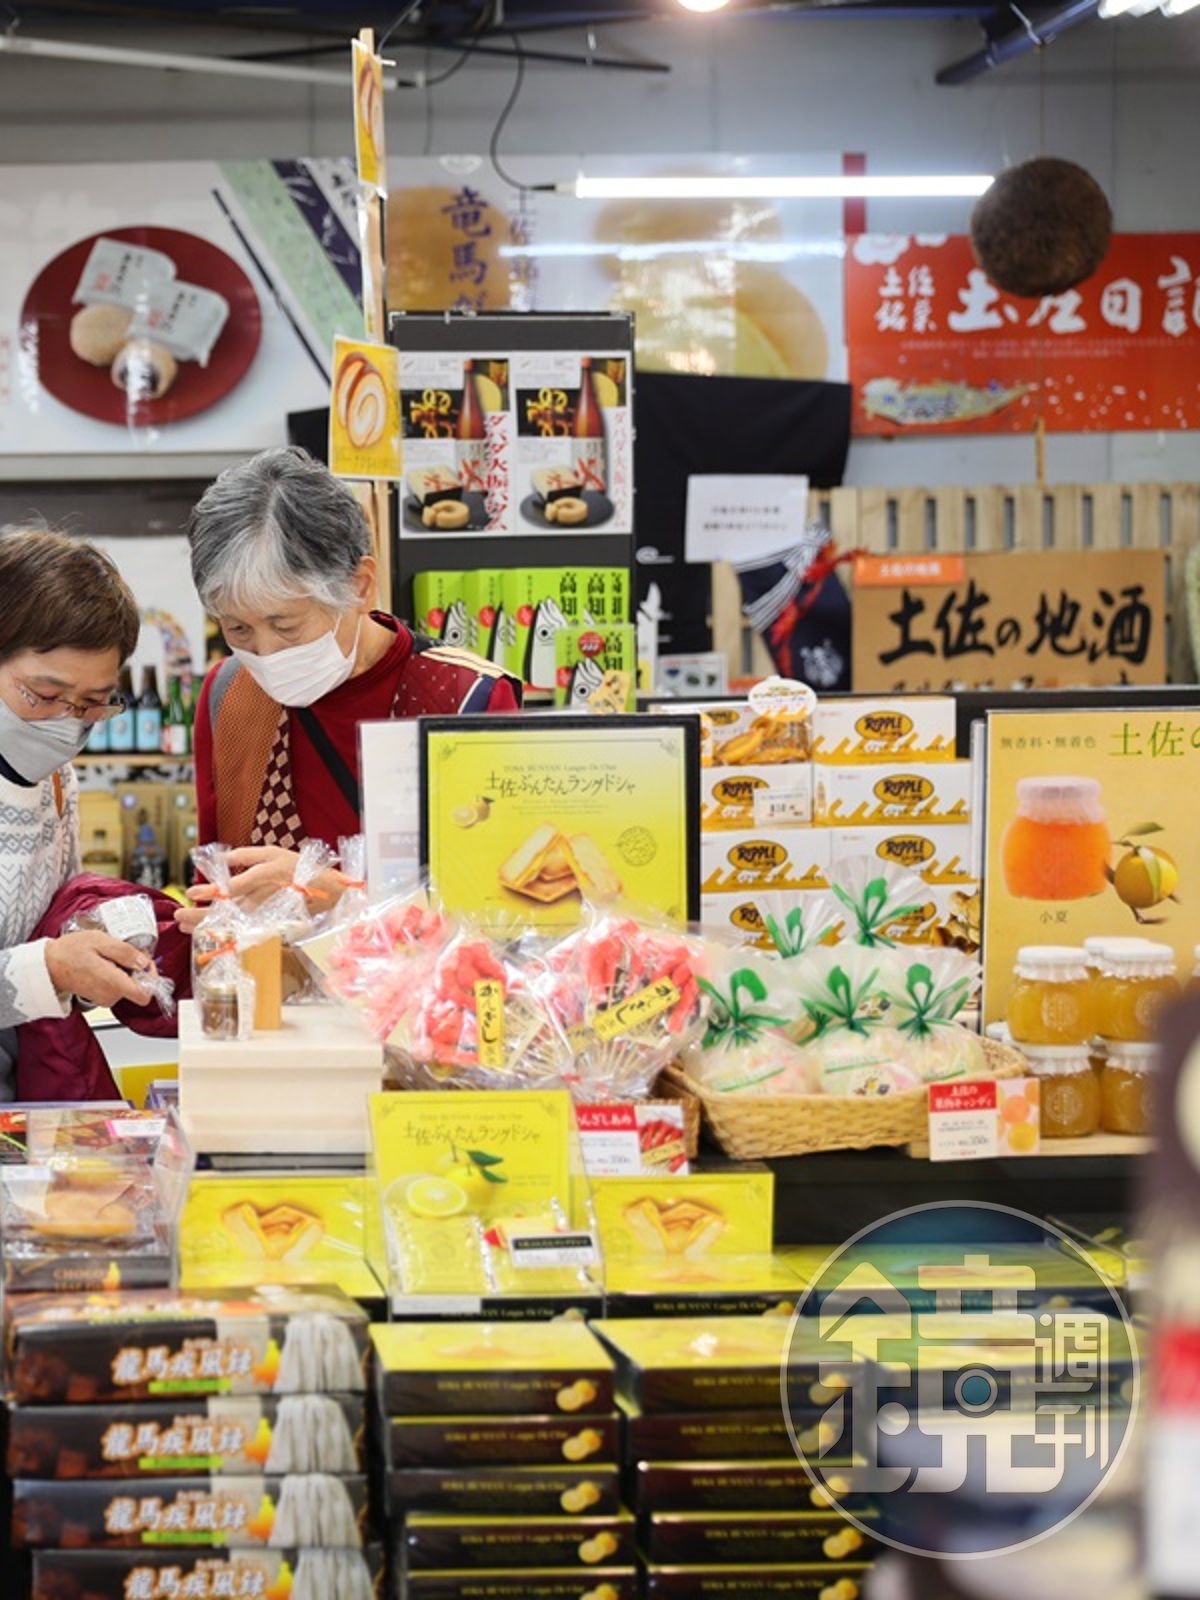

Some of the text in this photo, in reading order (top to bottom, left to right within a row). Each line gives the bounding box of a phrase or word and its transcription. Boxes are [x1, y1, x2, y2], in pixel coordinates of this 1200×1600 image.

[879, 580, 1154, 667] 土佐の地酒
